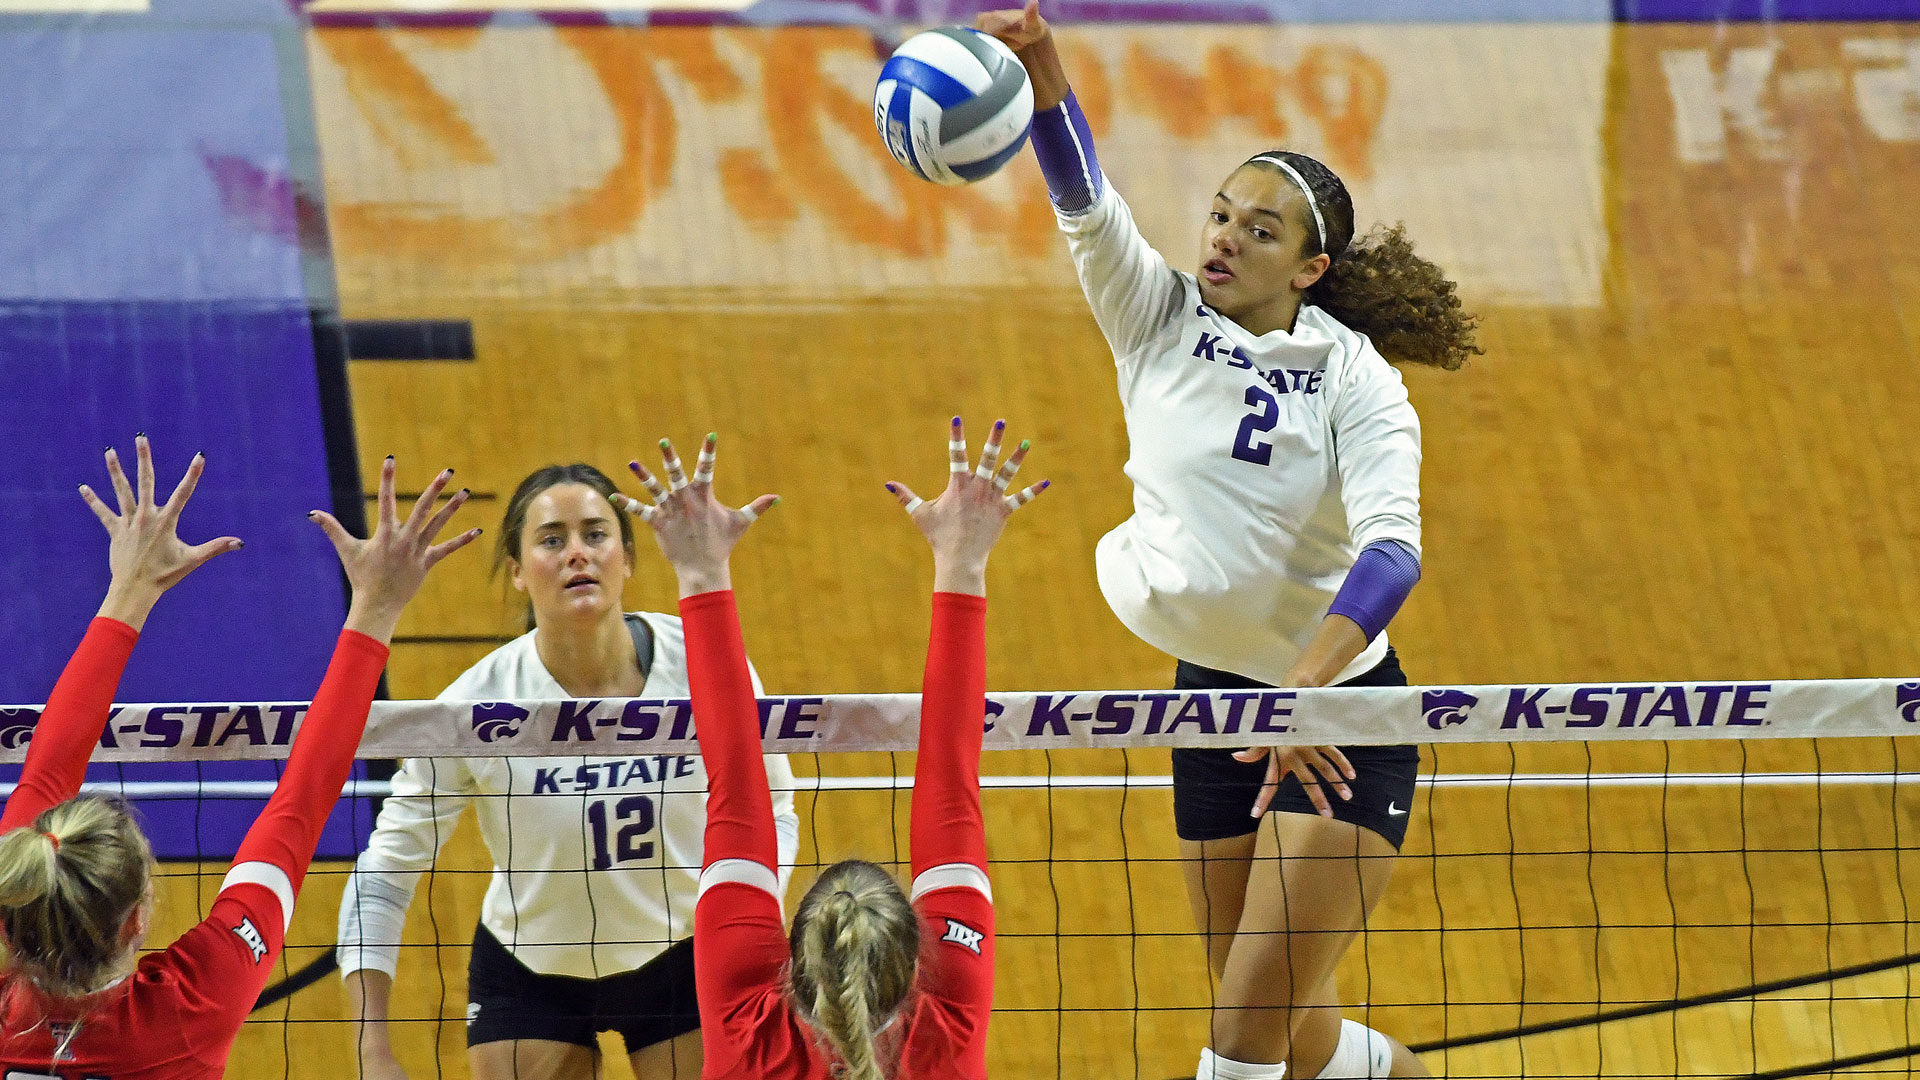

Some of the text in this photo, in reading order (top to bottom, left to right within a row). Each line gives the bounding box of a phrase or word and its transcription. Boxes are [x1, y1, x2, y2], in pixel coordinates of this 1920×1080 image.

[1192, 332, 1325, 394] K-SATE
[1231, 385, 1279, 466] 2
[551, 698, 823, 741] K-STTE
[1026, 692, 1297, 736] K-STATE
[1500, 684, 1772, 729] K-STATE
[533, 755, 695, 794] K-STATE
[588, 795, 655, 870] 12
